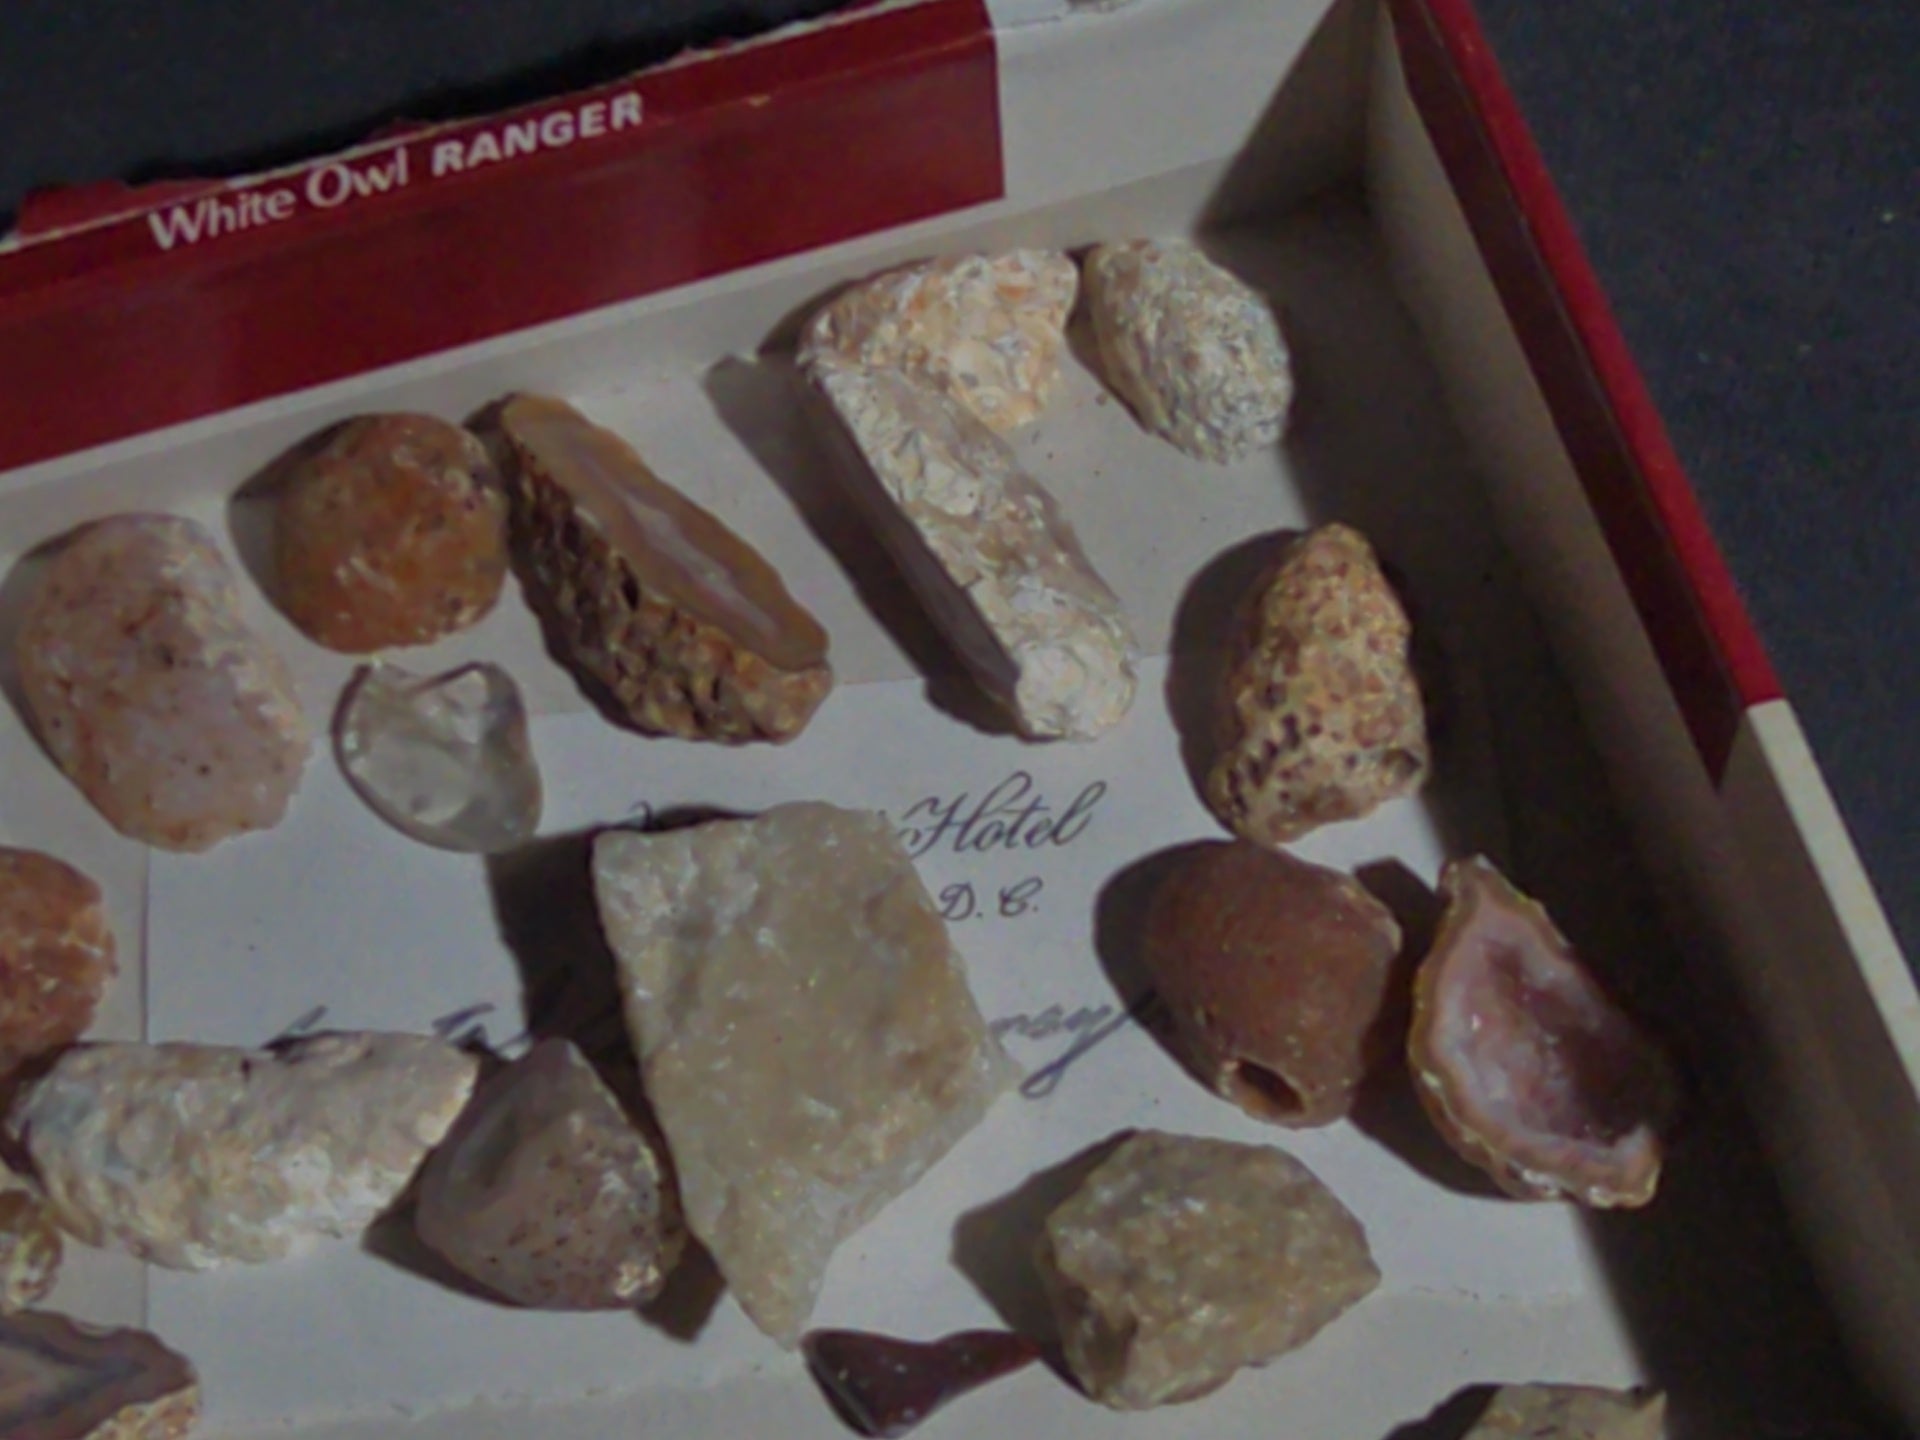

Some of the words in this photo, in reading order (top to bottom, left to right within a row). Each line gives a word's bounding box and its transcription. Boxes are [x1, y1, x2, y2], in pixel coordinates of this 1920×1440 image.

[147, 187, 297, 250] White
[305, 146, 409, 208] Owl
[431, 91, 644, 177] RANGER
[898, 769, 1107, 858] Hotel
[938, 881, 984, 922] D.
